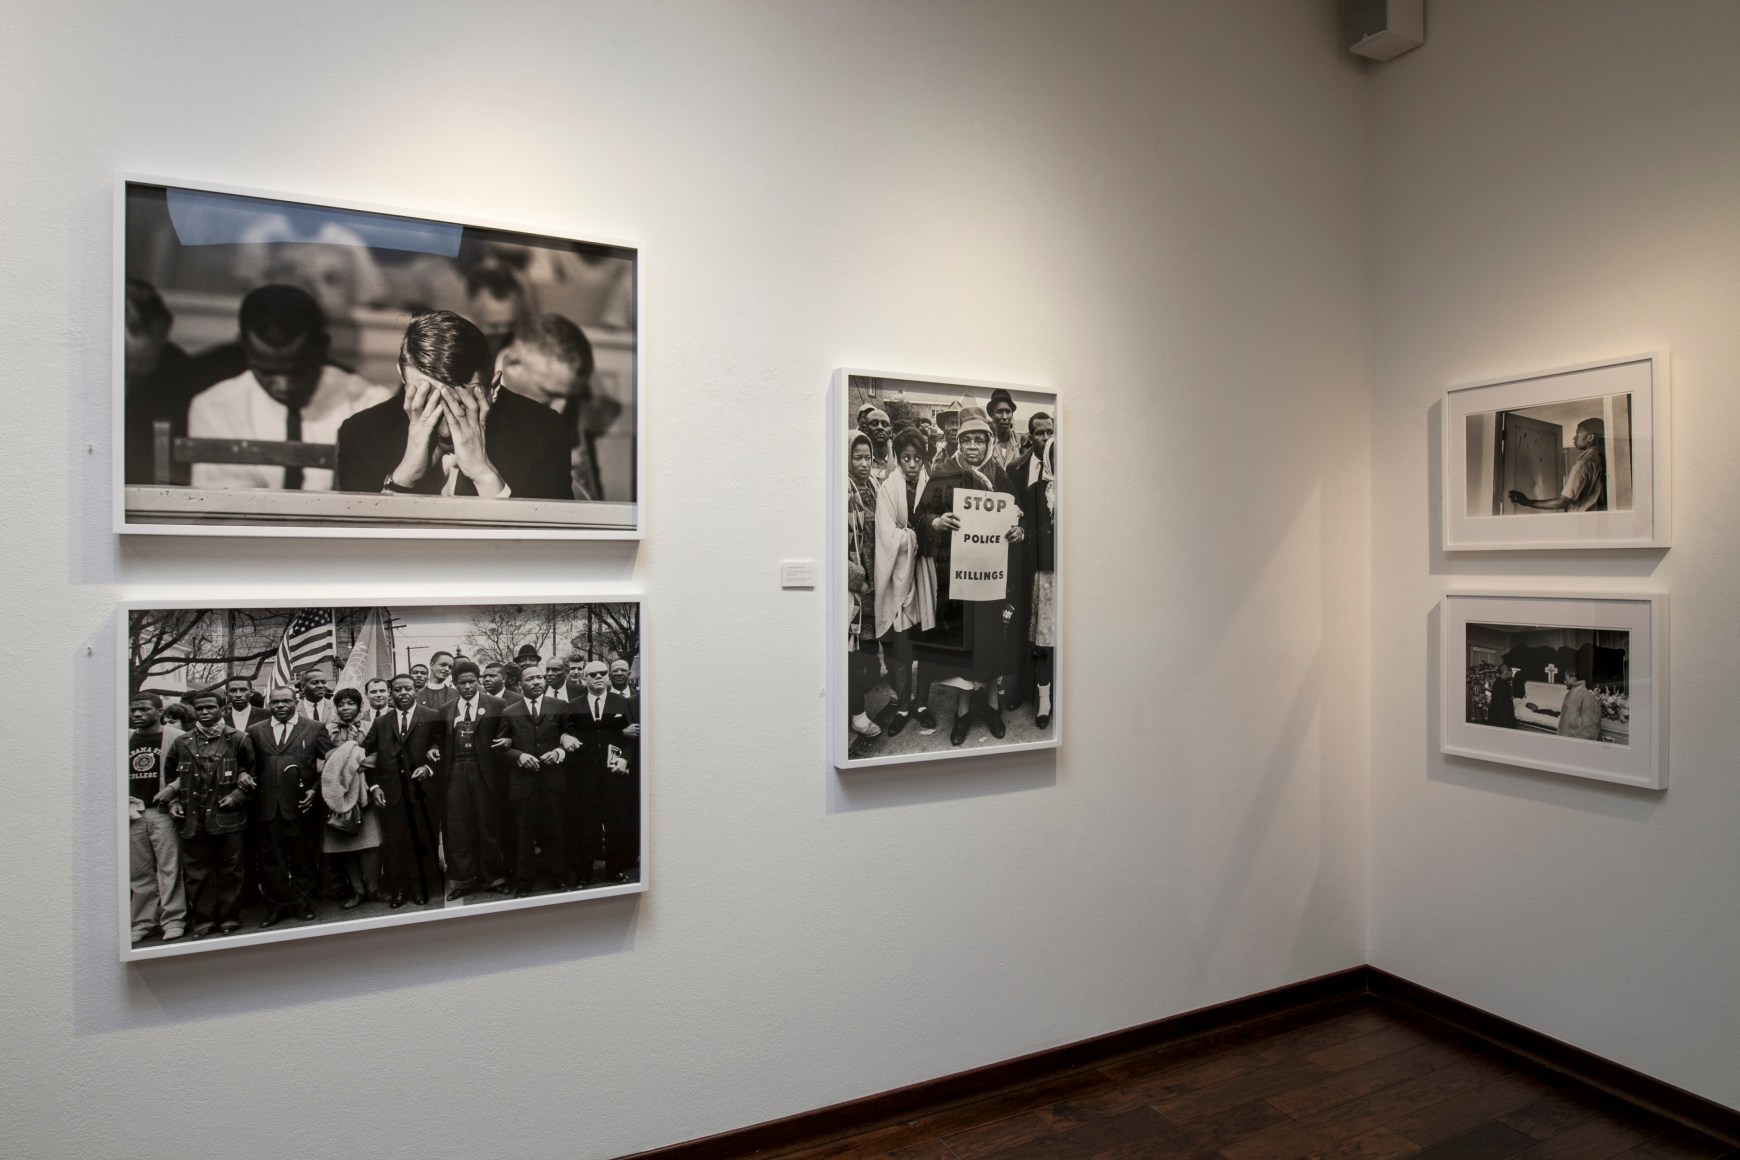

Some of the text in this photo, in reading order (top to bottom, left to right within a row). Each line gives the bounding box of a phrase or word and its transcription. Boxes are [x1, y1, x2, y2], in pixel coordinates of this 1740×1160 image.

[963, 495, 1007, 513] STOP
[963, 533, 1001, 544] POLICE
[955, 570, 1004, 580] KILLINGS
